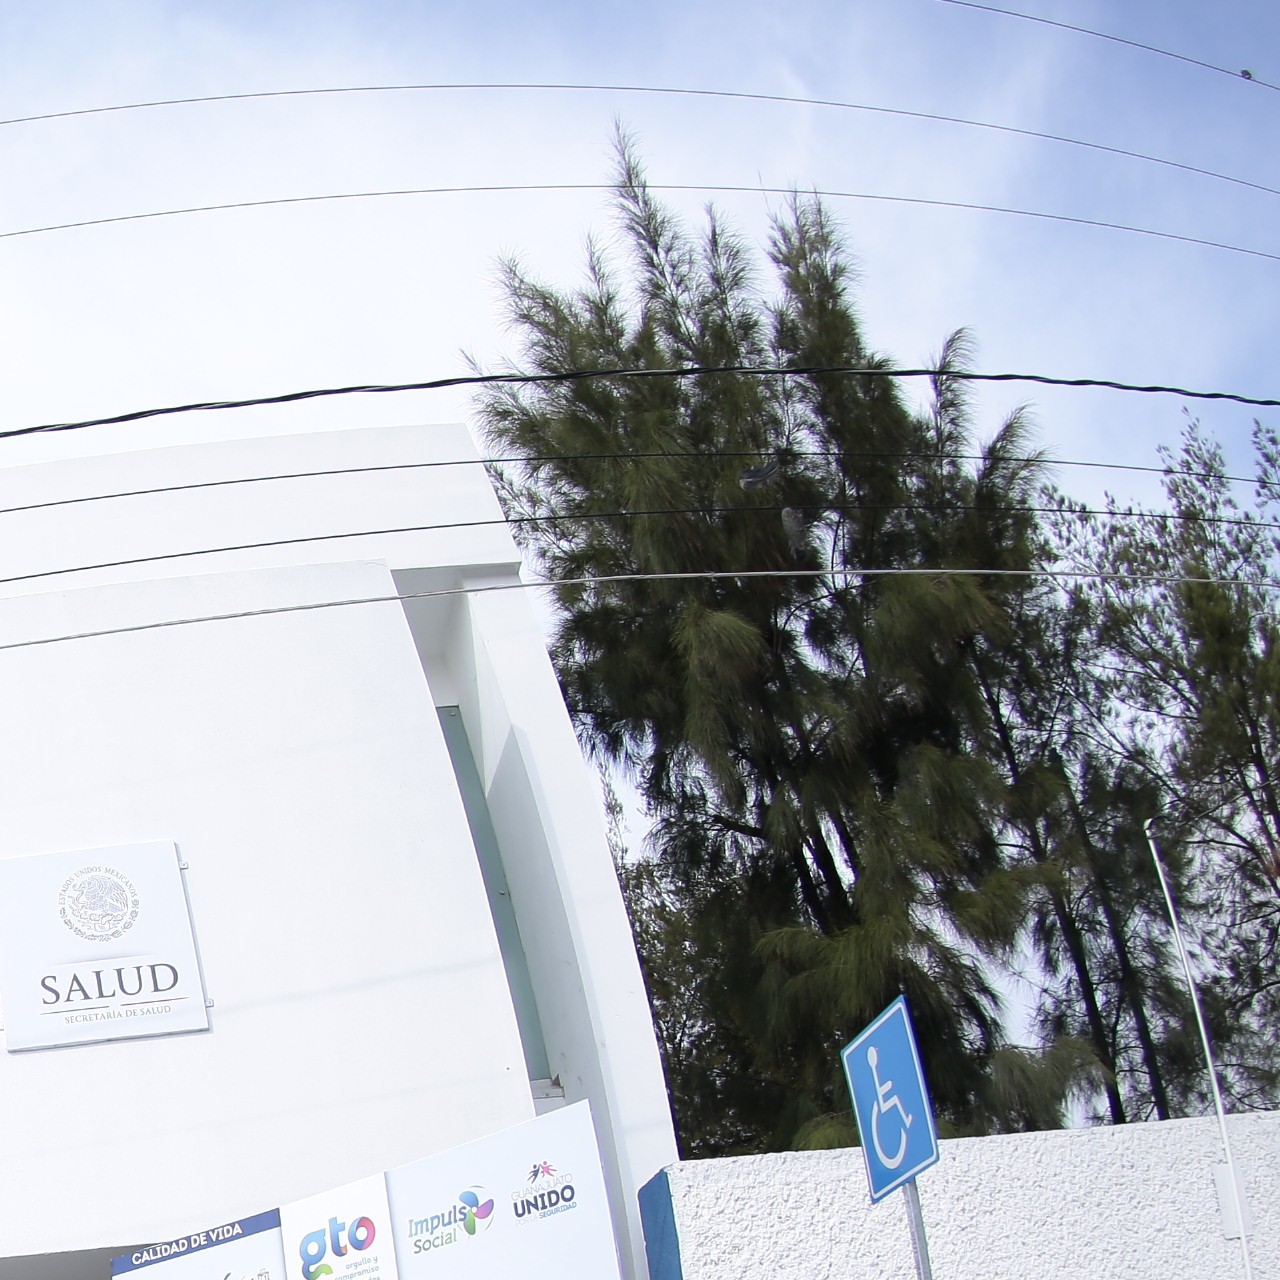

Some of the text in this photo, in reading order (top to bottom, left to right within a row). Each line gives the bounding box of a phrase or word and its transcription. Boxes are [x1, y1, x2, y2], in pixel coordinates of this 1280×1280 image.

[58, 866, 138, 906] ESTADOS UNIDOS MEXICANOS
[41, 963, 179, 1006] SALUD
[65, 1005, 172, 1025] SECRETARÍA DE SALUD
[511, 1174, 573, 1201] GUANAJUATO
[513, 1185, 575, 1218] UNIDO
[539, 1202, 577, 1219] SEGURIDAD
[132, 1223, 242, 1265] CALIDAD DE VIDA
[299, 1216, 375, 1280] gto
[414, 1228, 457, 1254] Social
[346, 1257, 371, 1269] orgullo
